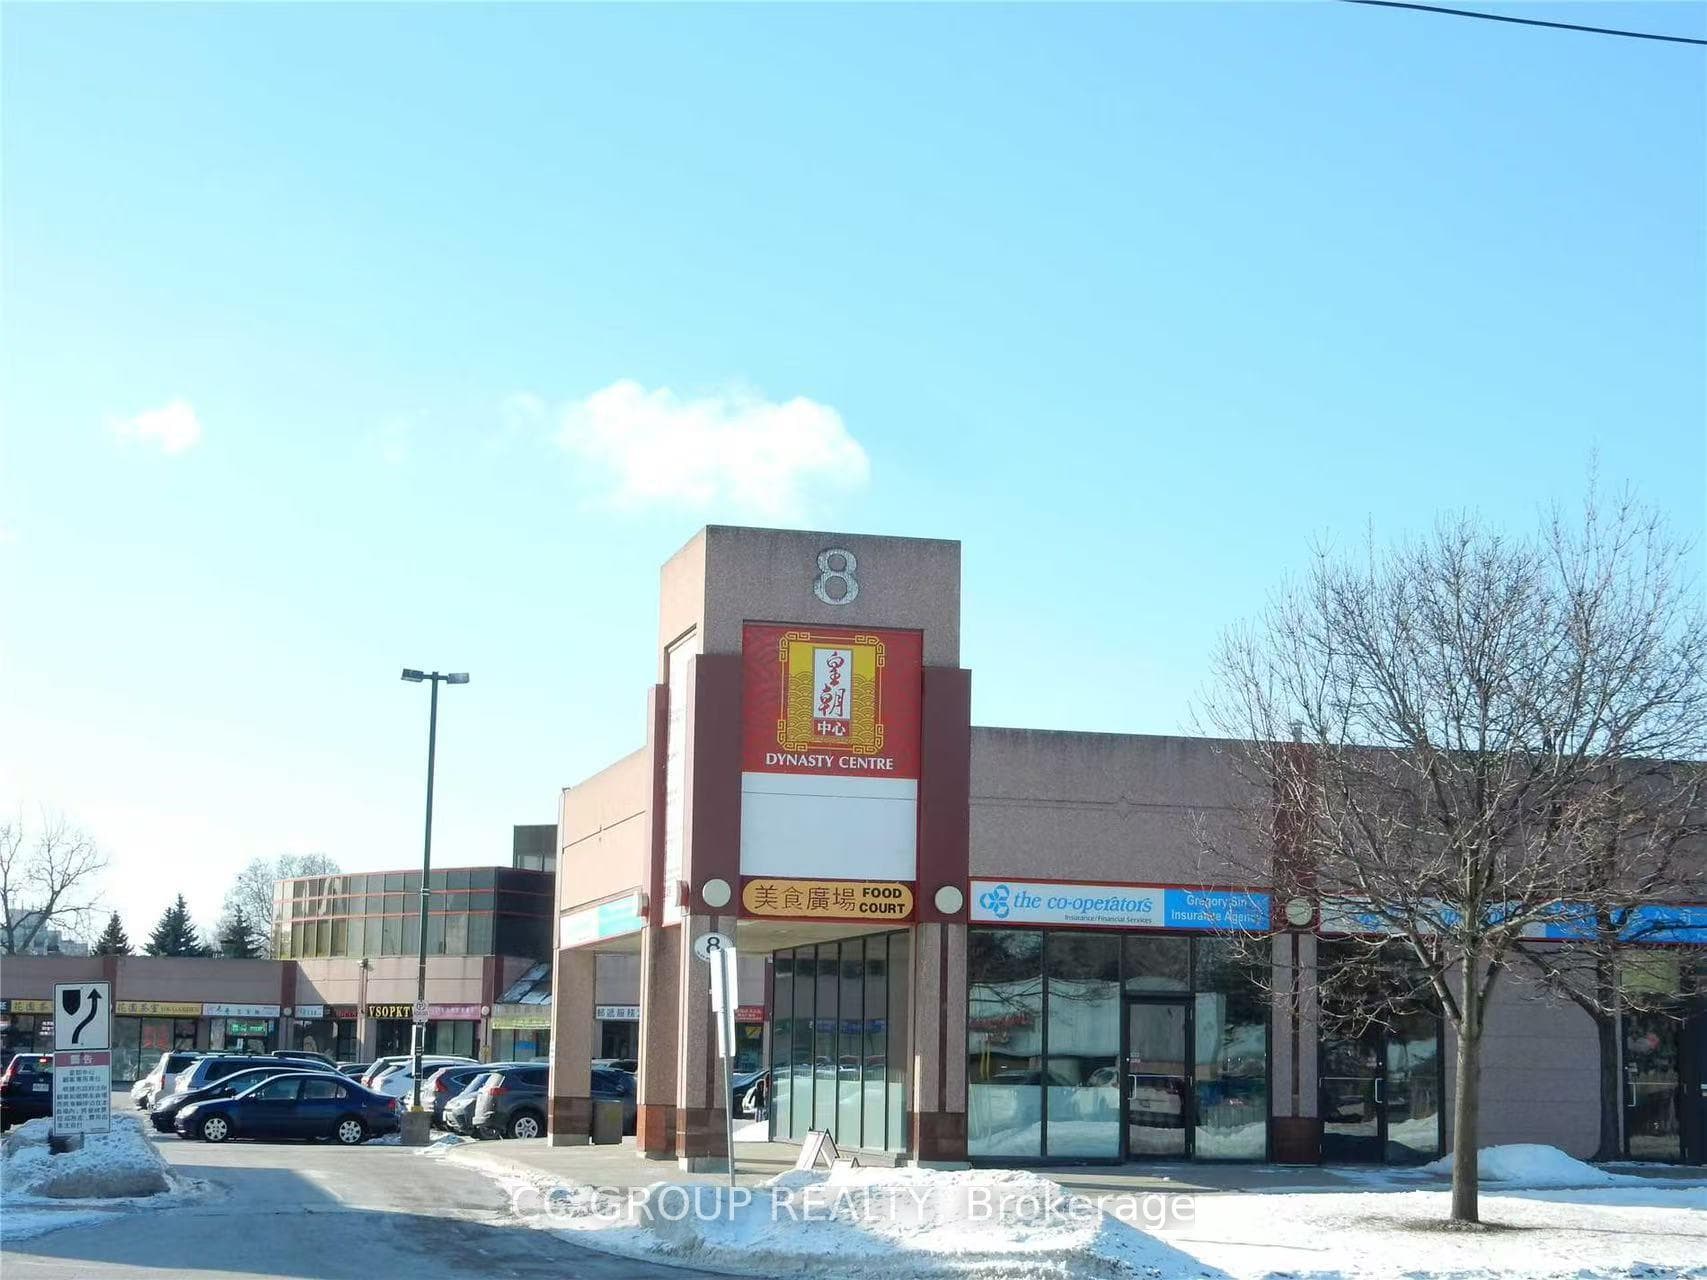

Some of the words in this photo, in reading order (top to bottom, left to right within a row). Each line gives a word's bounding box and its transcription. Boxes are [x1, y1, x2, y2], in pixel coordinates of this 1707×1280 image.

[813, 547, 860, 606] 8
[818, 650, 846, 717] 皇朝
[817, 720, 847, 737] 中心
[765, 752, 834, 768] DYNASTY
[839, 756, 894, 770] CENTRE
[754, 884, 856, 912] 美食廣場
[862, 887, 903, 899] FOOD
[1186, 894, 1228, 908] Gregory
[859, 902, 906, 914] COURT
[1013, 890, 1042, 909] the
[1047, 896, 1153, 914] co-operators
[1224, 911, 1261, 924] Agen
[706, 936, 720, 953] 8
